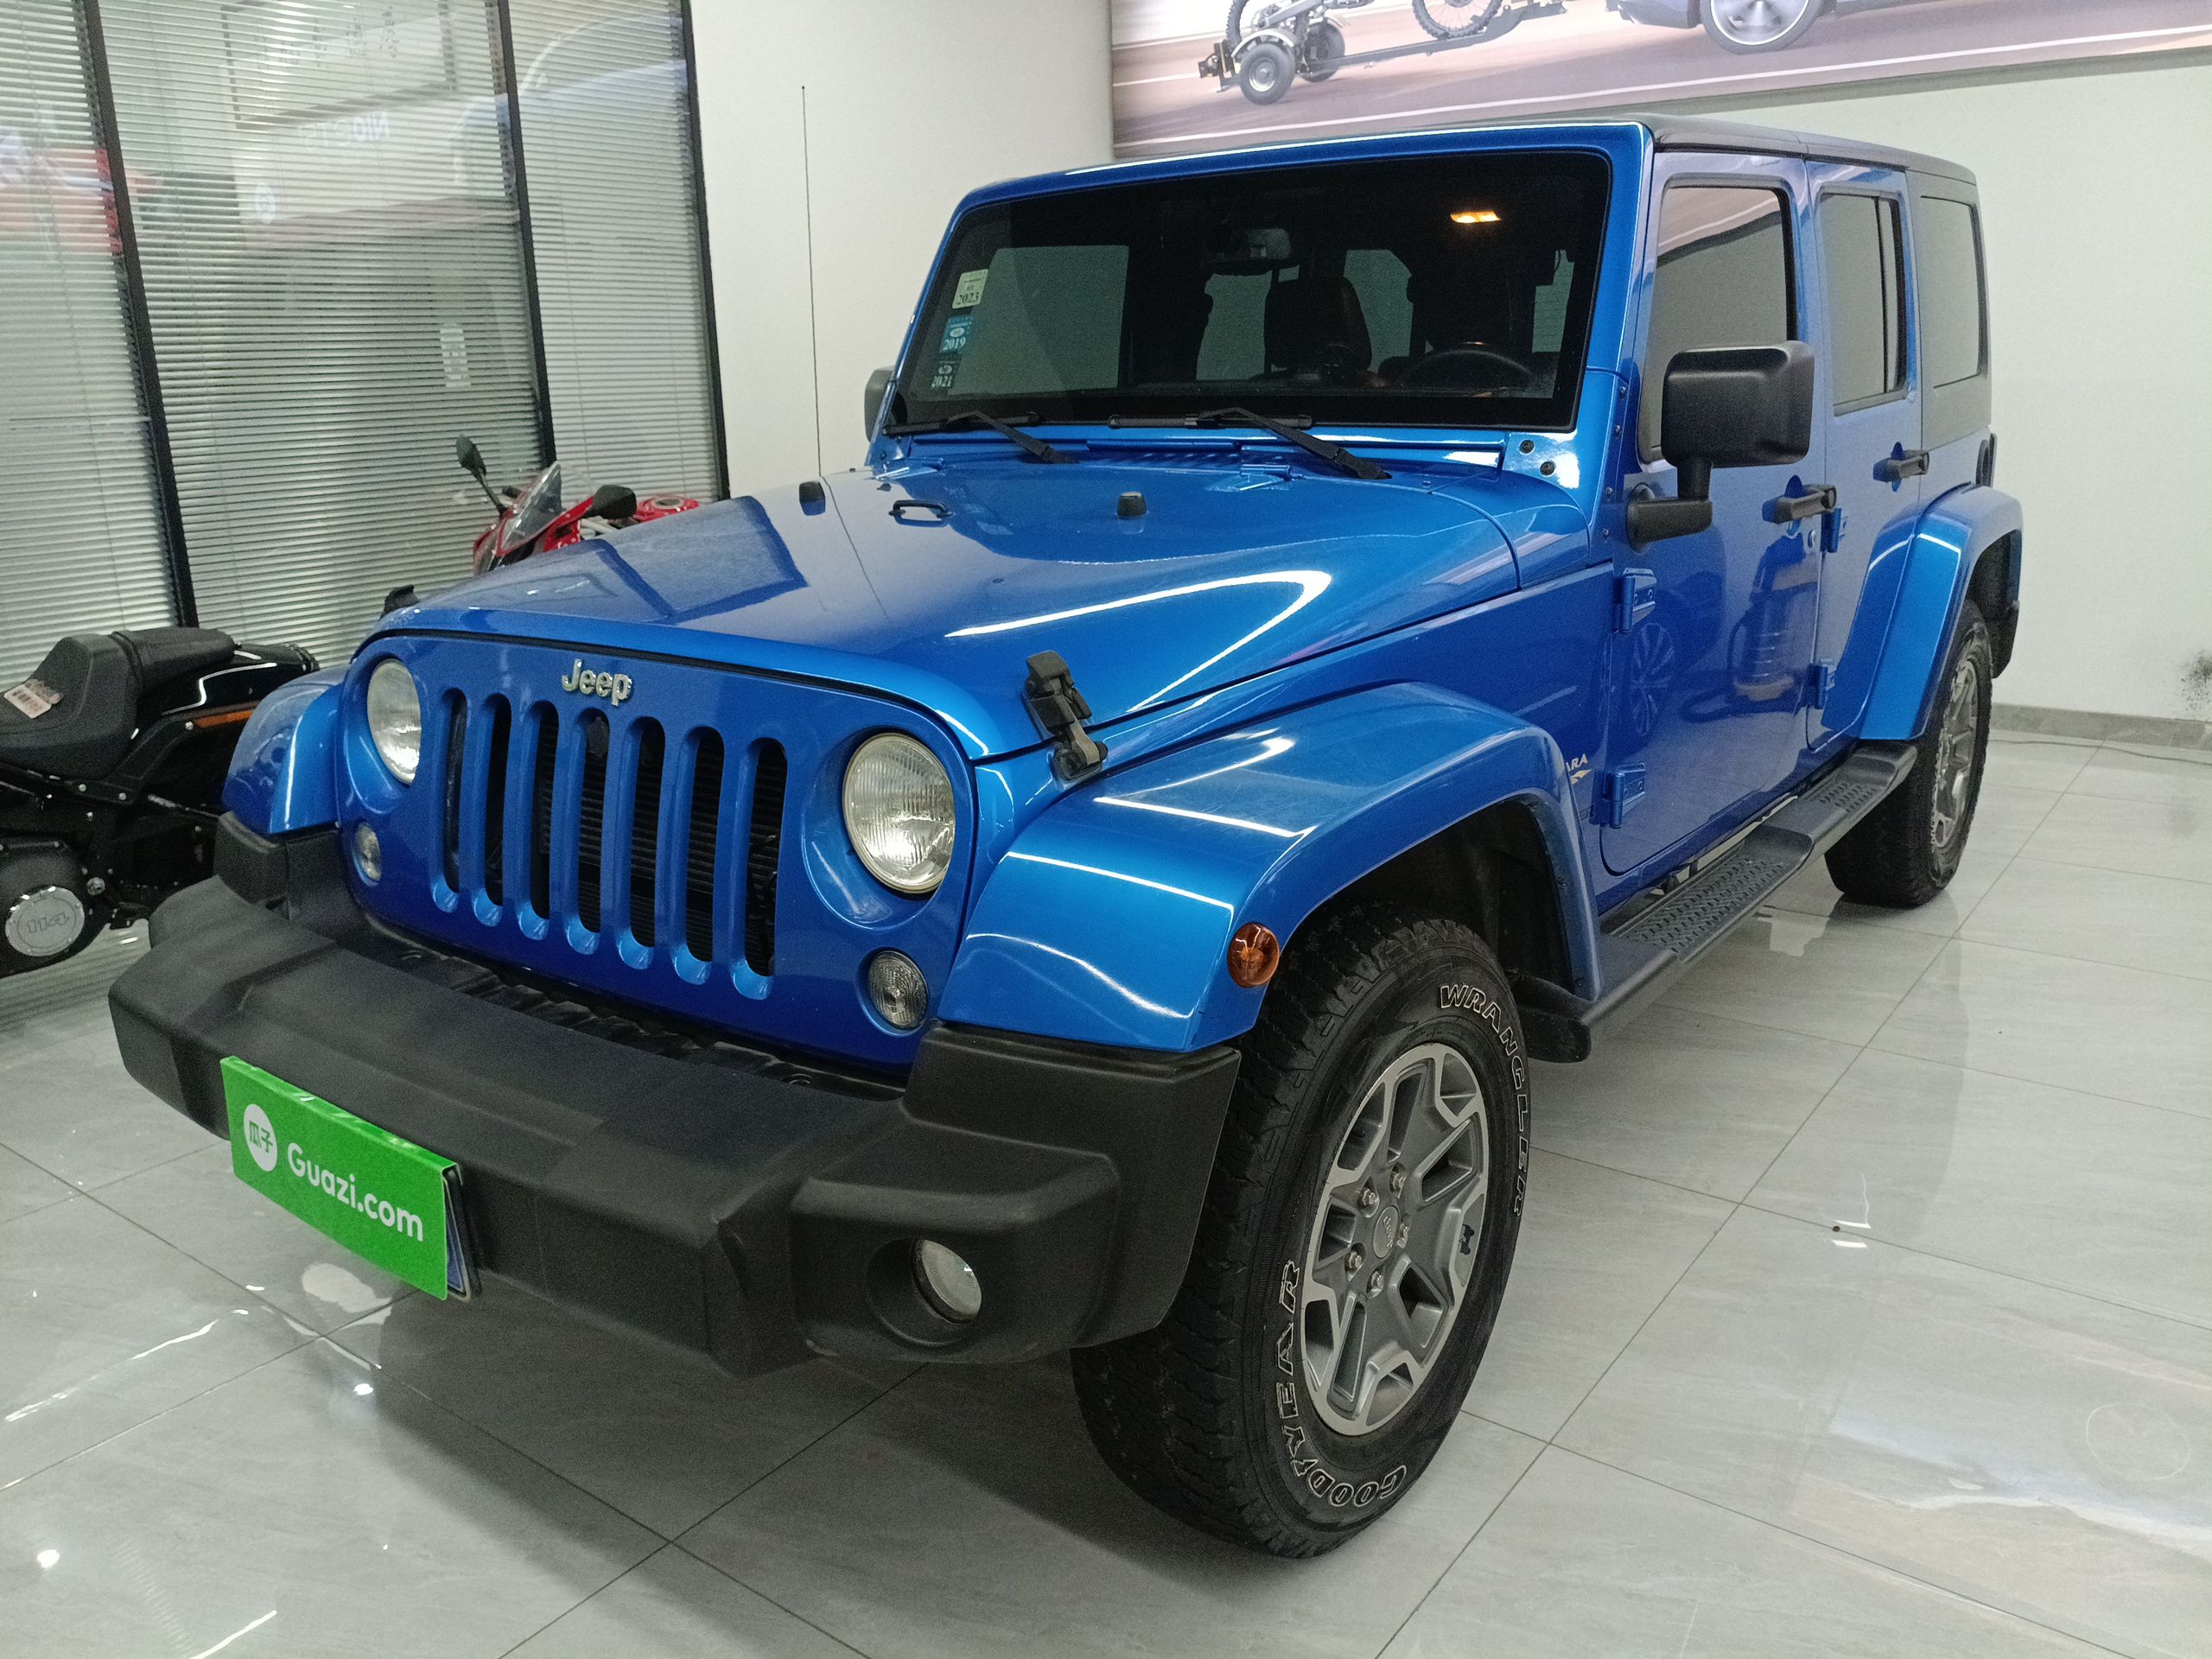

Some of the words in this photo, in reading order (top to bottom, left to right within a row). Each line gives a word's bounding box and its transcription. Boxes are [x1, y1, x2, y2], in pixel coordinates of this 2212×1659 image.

[957, 292, 979, 305] 2023
[942, 337, 966, 351] 2019
[931, 375, 952, 388] 2021
[561, 658, 632, 706] Jeep
[1440, 984, 1529, 1217] WRANGLER
[249, 1120, 274, 1154] 瓜子
[287, 1142, 423, 1242] Guazi.com
[1275, 1259, 1408, 1507] GOODYEAR
